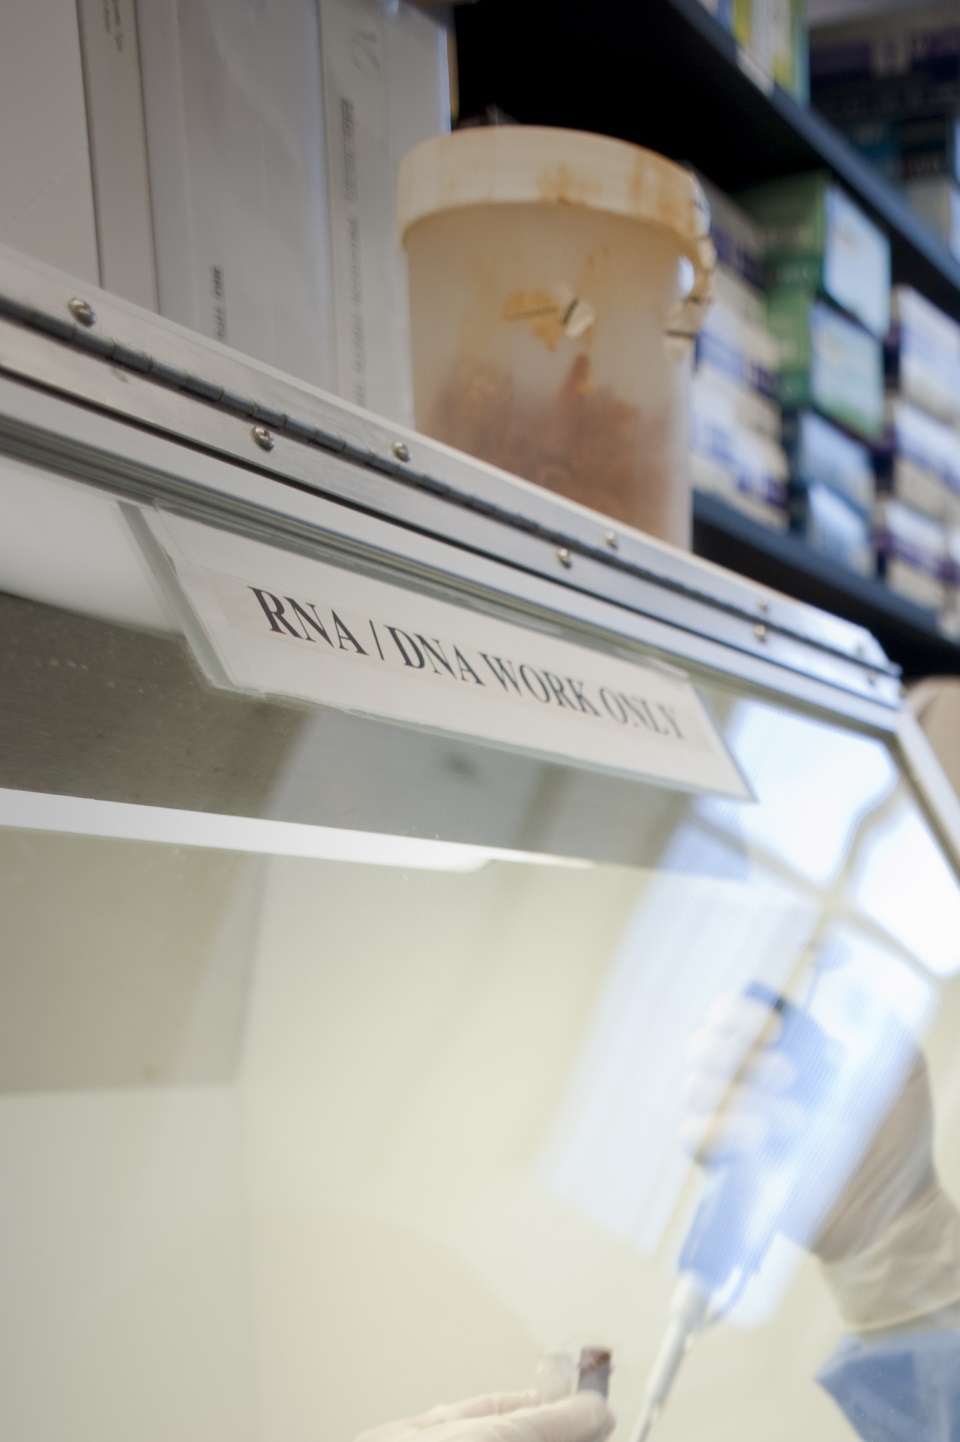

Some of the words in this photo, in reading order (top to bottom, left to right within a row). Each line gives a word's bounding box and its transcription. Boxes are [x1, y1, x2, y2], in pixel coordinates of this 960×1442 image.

[247, 586, 370, 657] RNA
[383, 624, 487, 686] DNA
[478, 652, 601, 718] WORK
[599, 687, 685, 740] ONLY
